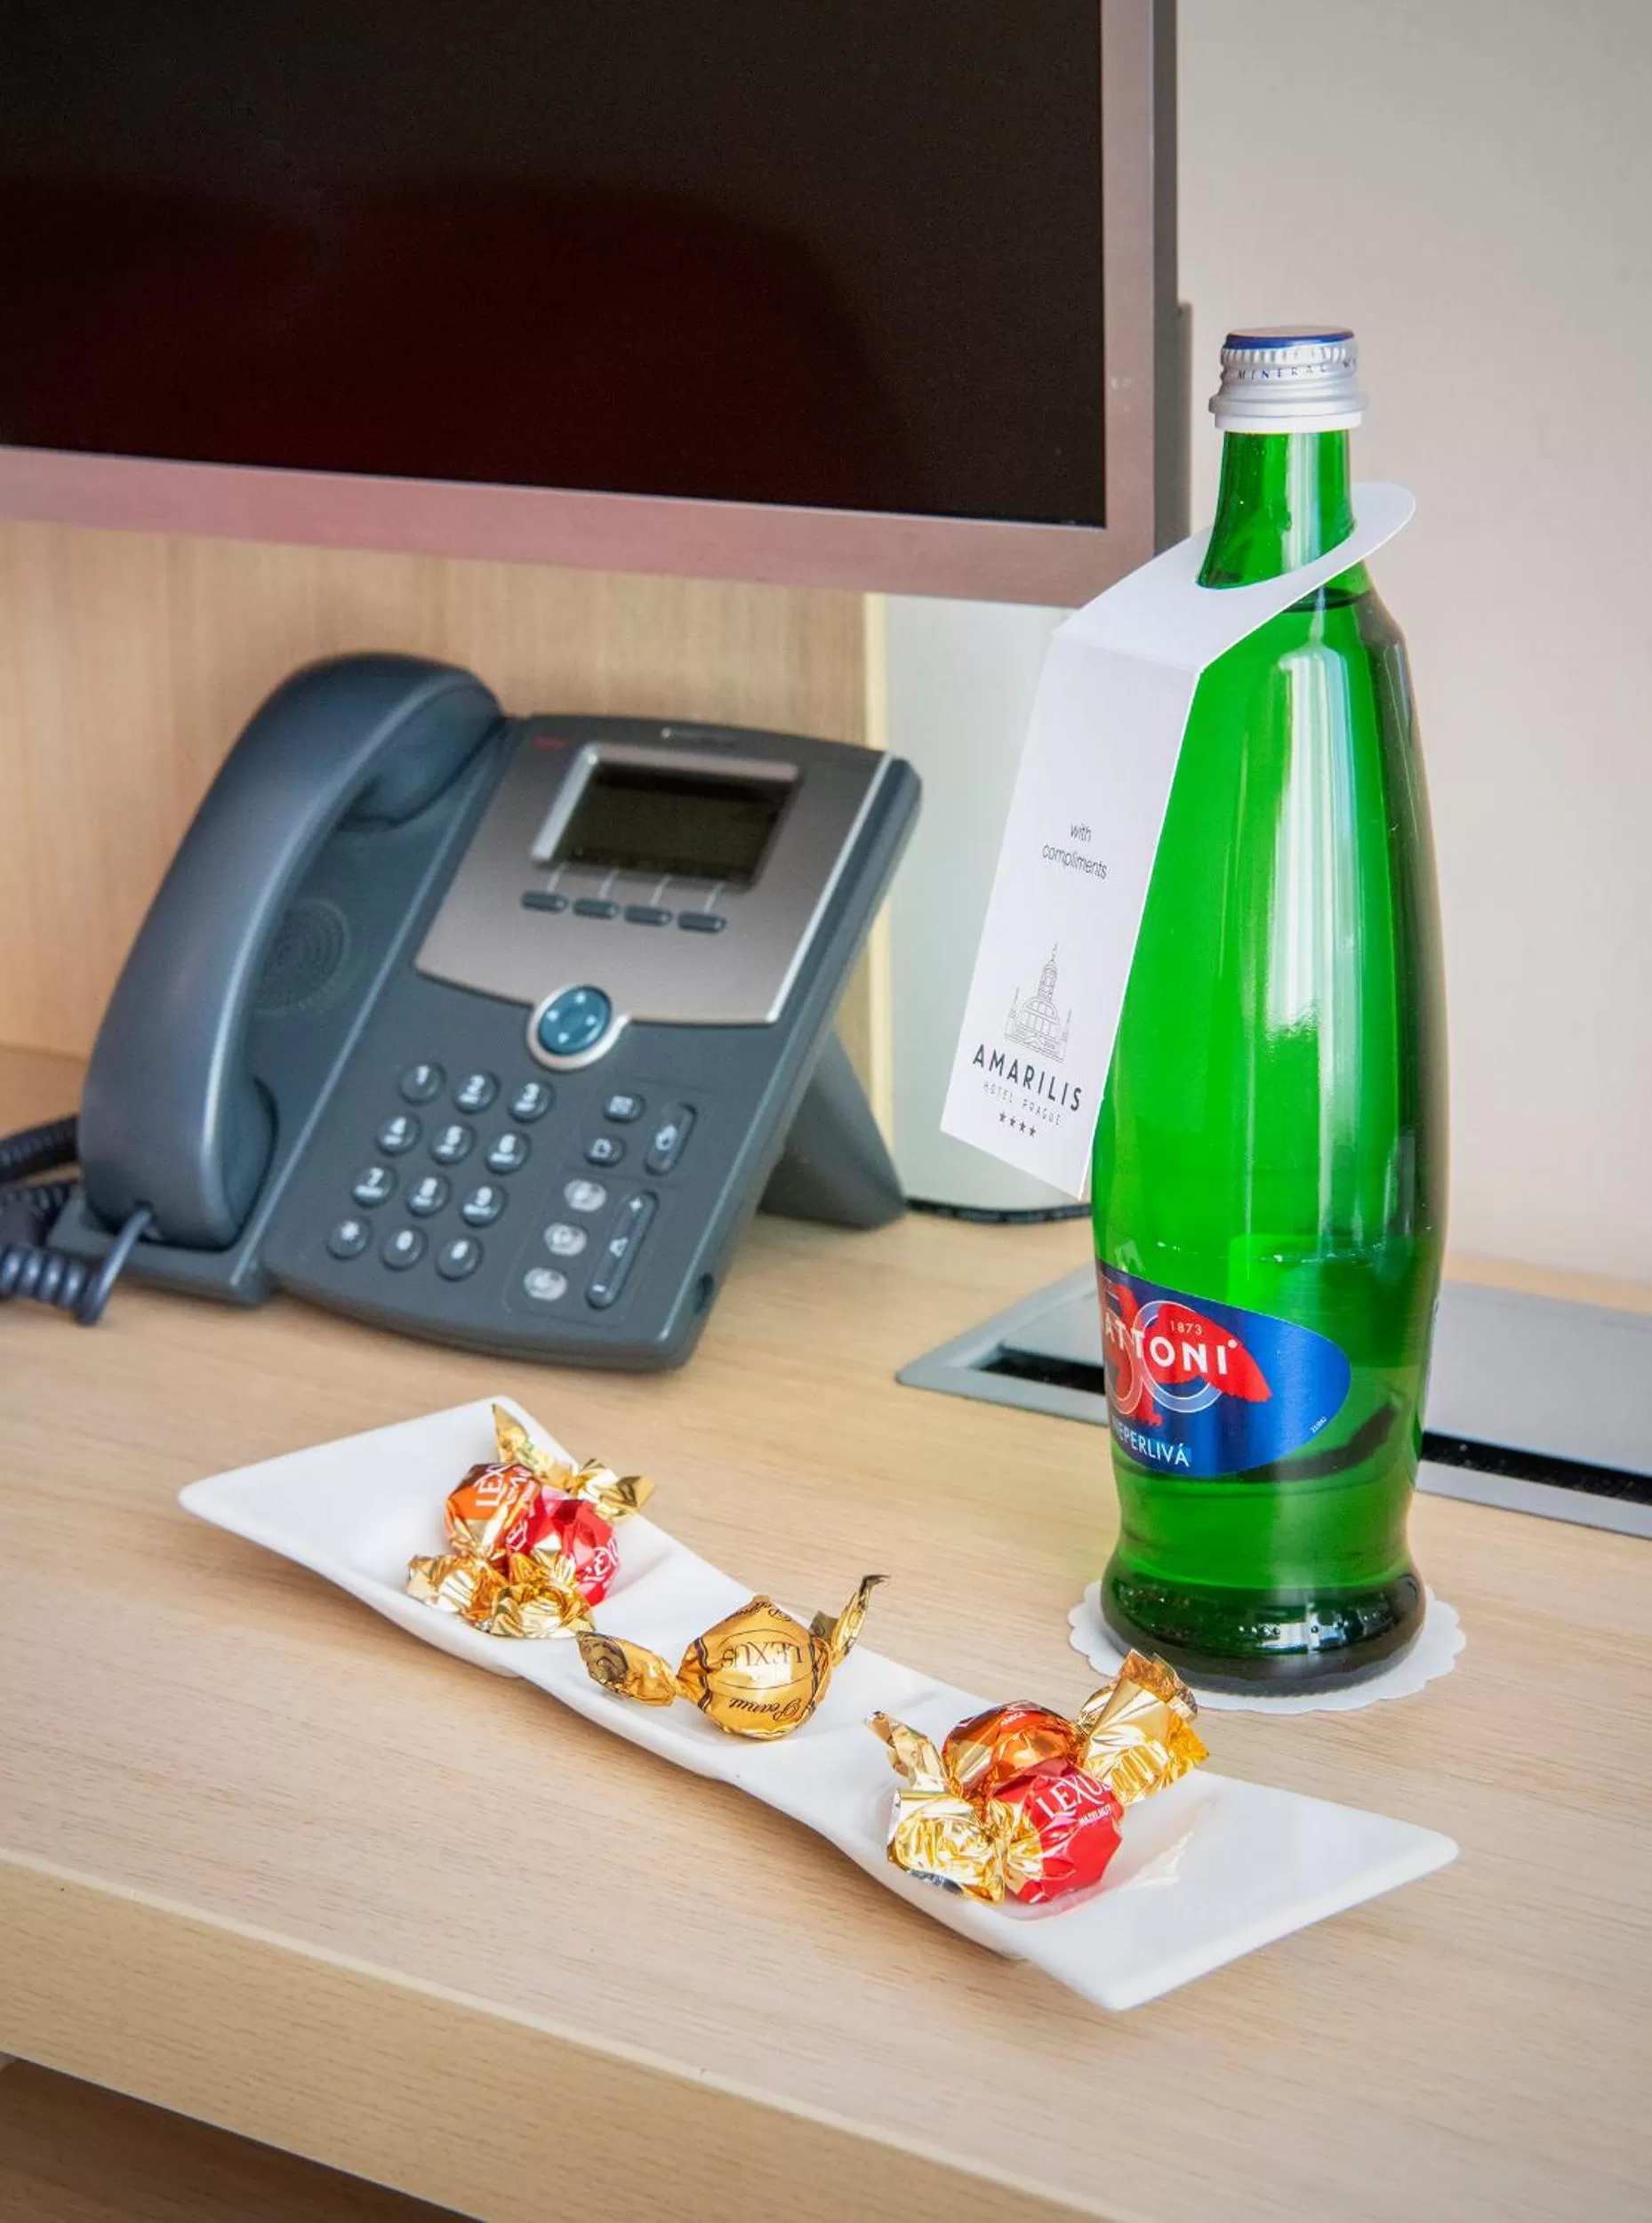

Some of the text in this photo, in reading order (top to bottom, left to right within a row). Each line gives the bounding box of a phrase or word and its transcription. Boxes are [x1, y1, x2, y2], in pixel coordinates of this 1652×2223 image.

[1070, 823, 1092, 842] with
[1042, 844, 1108, 879] compliments
[973, 1043, 1082, 1112] AMARILIS
[1169, 1320, 1203, 1336] 1873
[1104, 1312, 1228, 1376] ATTONI
[721, 1641, 804, 1669] LEXUS
[727, 1698, 802, 1722] Peanut
